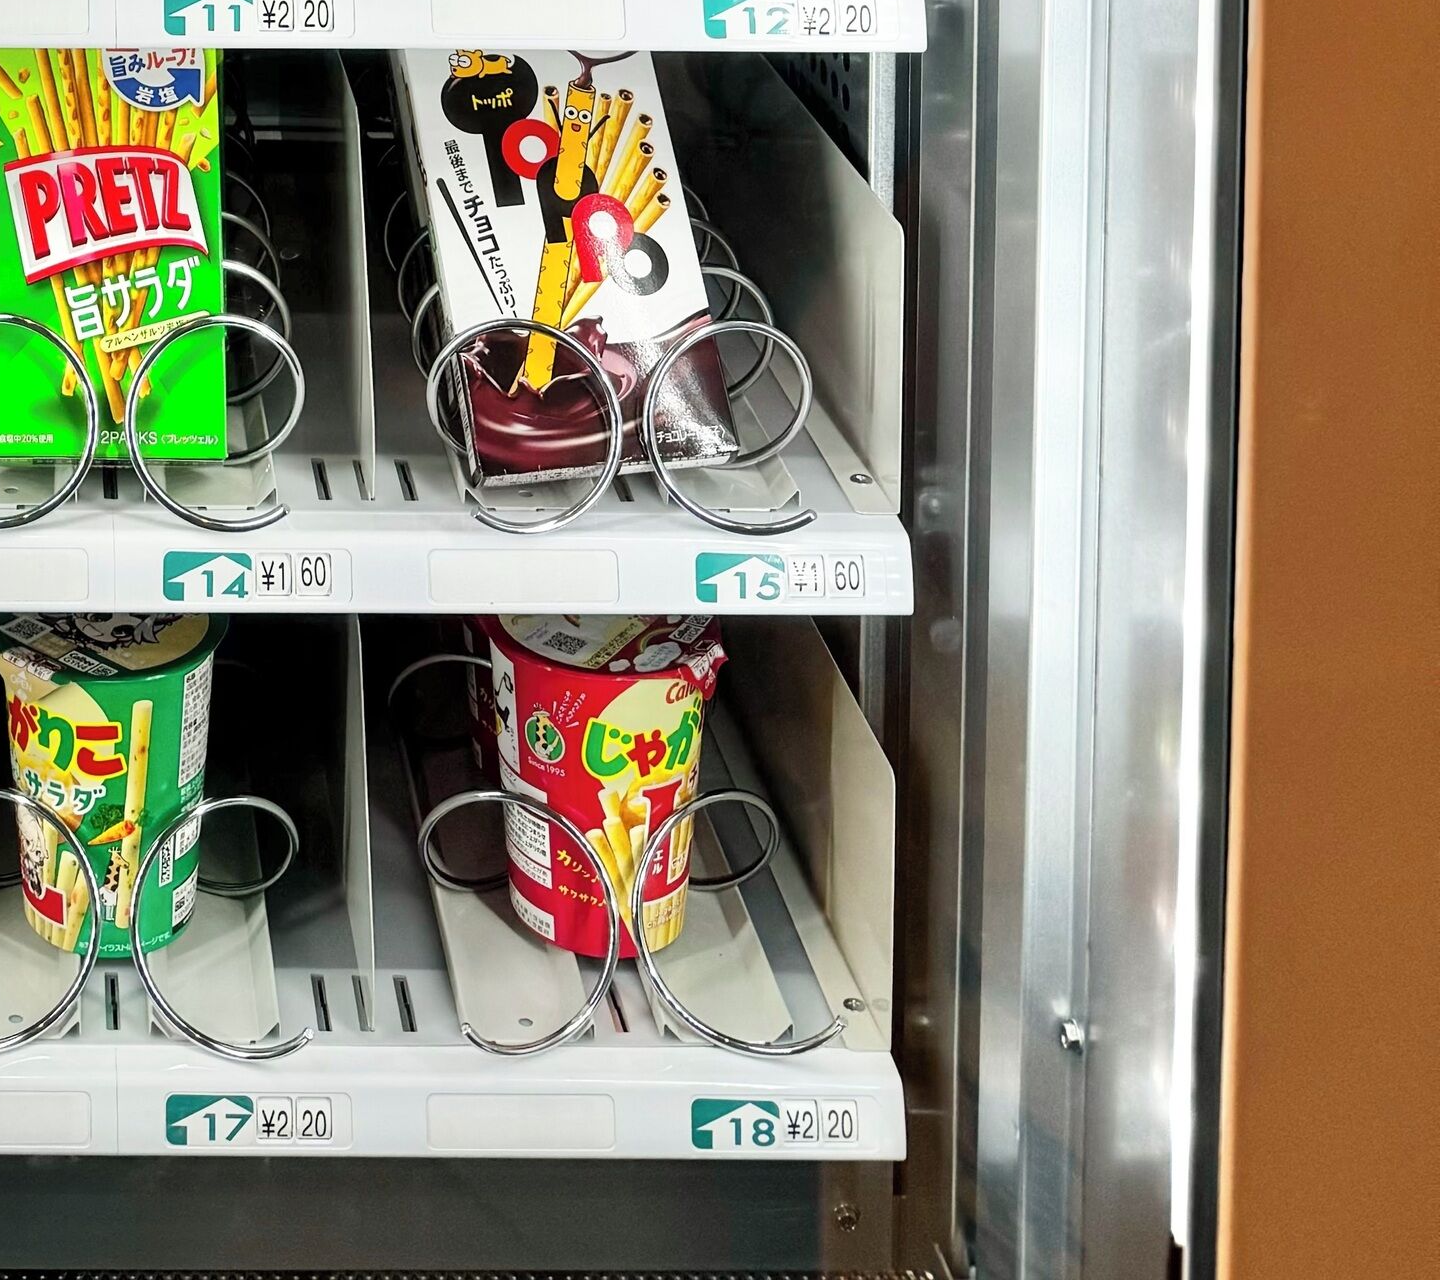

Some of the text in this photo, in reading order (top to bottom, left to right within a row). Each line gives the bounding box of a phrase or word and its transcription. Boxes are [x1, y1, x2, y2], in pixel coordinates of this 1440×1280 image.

[201, 3, 243, 33] 11
[741, 4, 794, 36] 12
[136, 85, 179, 104] 岩塩
[472, 88, 515, 112] トッポ
[17, 156, 192, 264] PRETZ
[64, 253, 203, 342] 旨サラダ
[201, 568, 250, 599] 14
[733, 571, 782, 601] 15
[546, 763, 566, 778] 1995
[24, 769, 107, 816] サラダ
[202, 1112, 253, 1143] 17
[728, 1118, 777, 1149] 18
